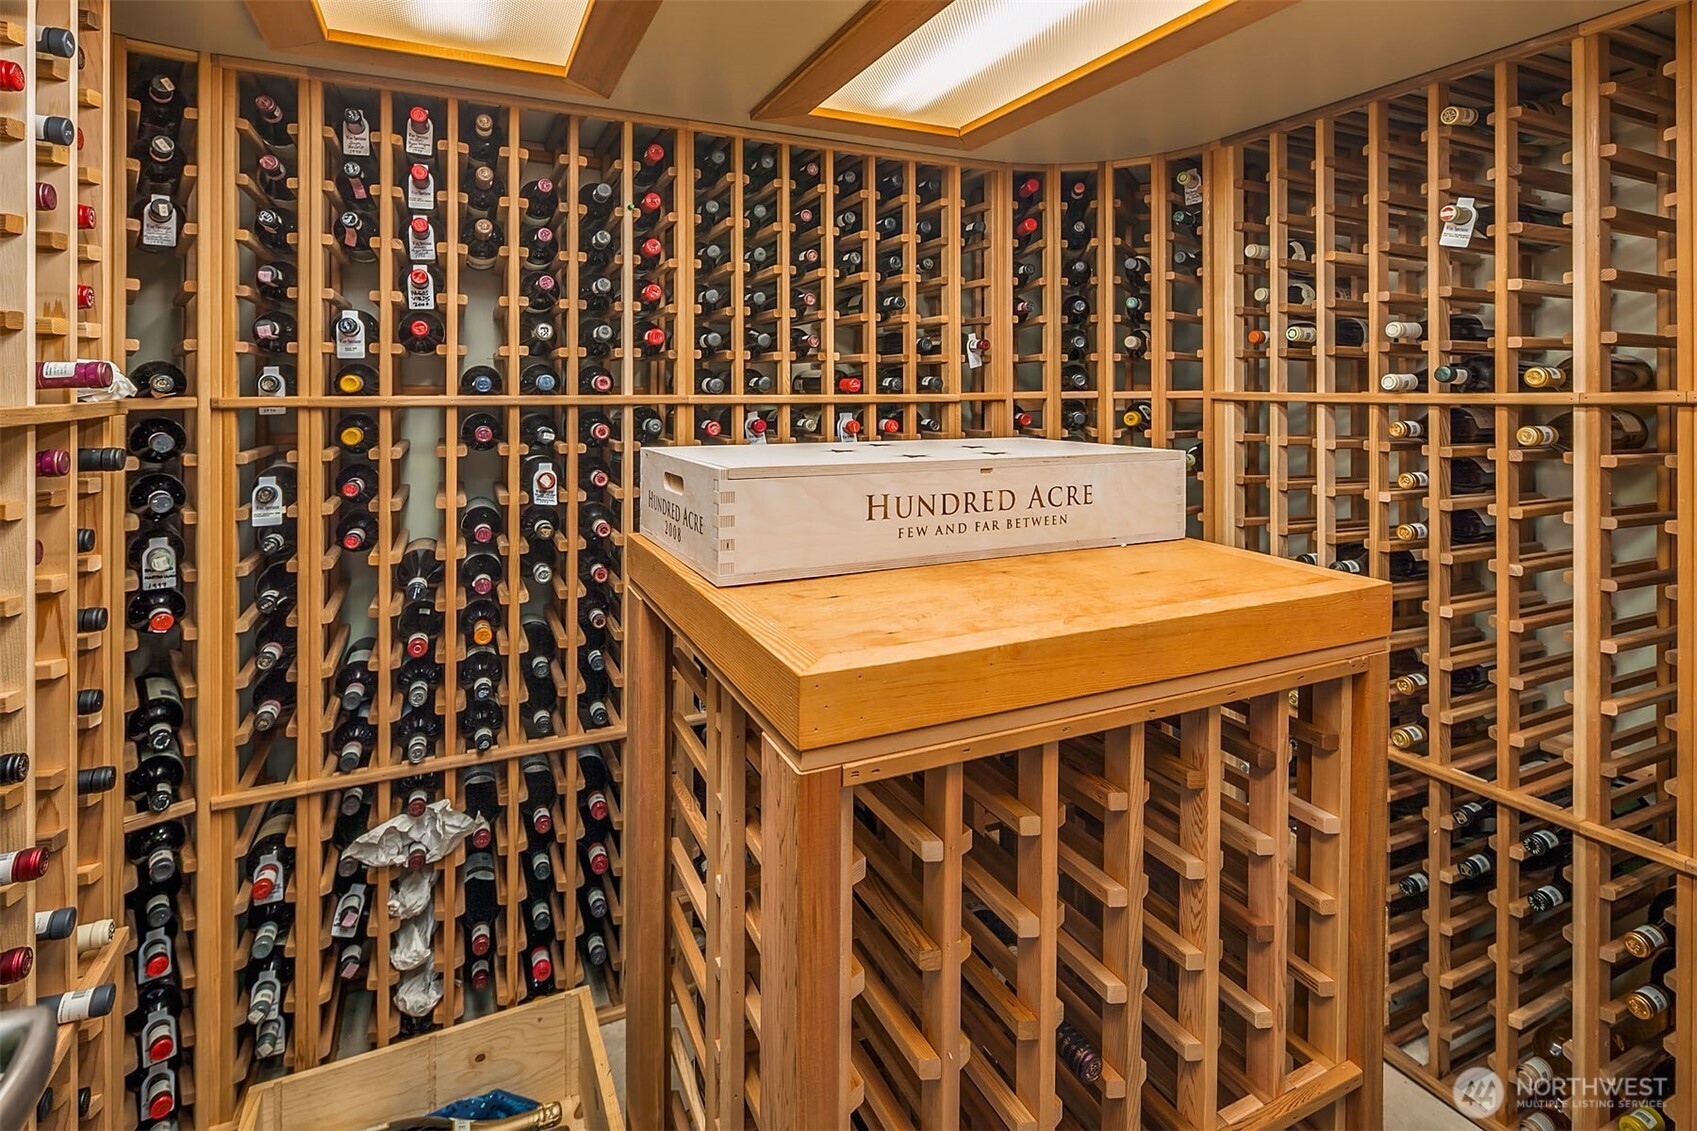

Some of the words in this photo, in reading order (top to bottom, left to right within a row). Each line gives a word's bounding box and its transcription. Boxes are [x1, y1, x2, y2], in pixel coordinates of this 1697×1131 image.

[648, 490, 681, 522] HUNDRED
[682, 507, 704, 535] ACRE
[866, 489, 1016, 521] HUNDRED
[1027, 484, 1094, 509] ACRE
[664, 520, 682, 543] 2008
[898, 525, 929, 539] FEW
[935, 522, 968, 536] AND
[975, 520, 1000, 532] FAR
[1006, 514, 1068, 530] BETWEEN
